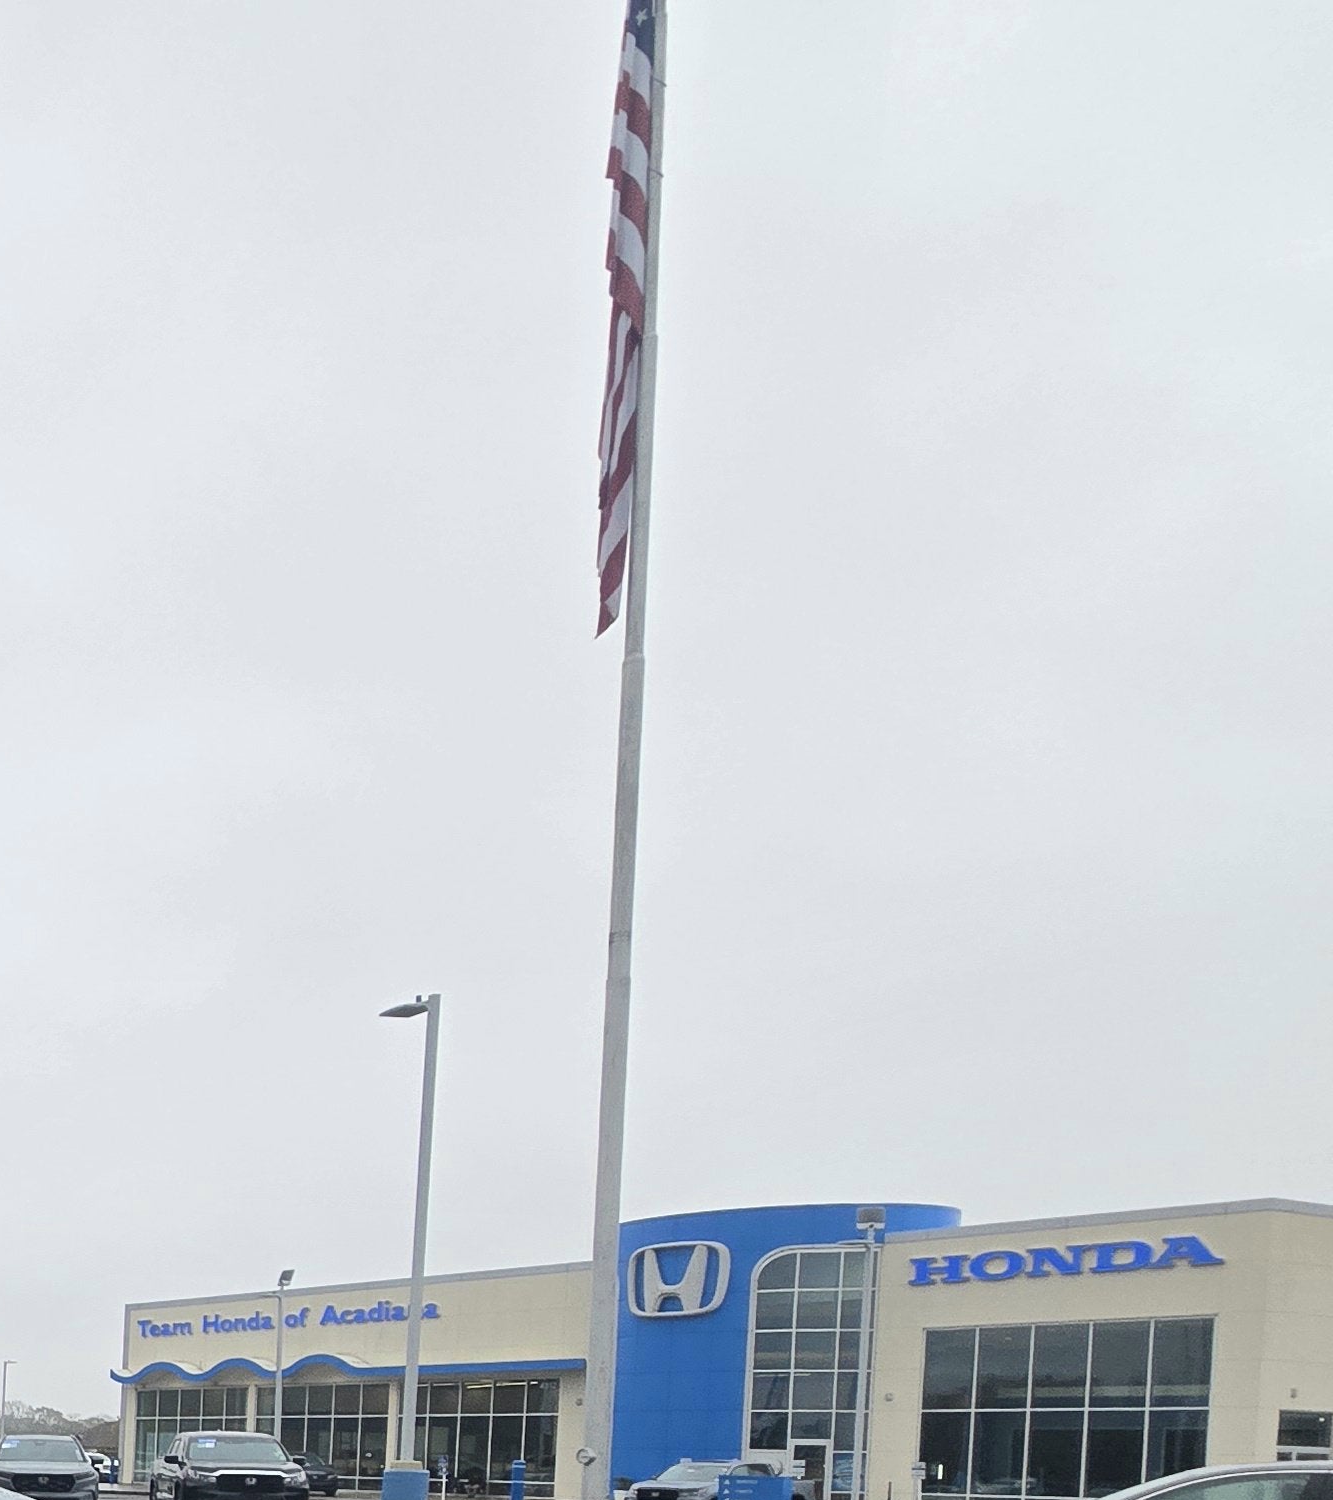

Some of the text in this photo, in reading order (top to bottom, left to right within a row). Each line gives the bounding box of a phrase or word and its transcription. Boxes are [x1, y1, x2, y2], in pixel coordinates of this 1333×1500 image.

[907, 1235, 1226, 1287] HONDA
[137, 1299, 441, 1338] Team Honda of Acadiaa
